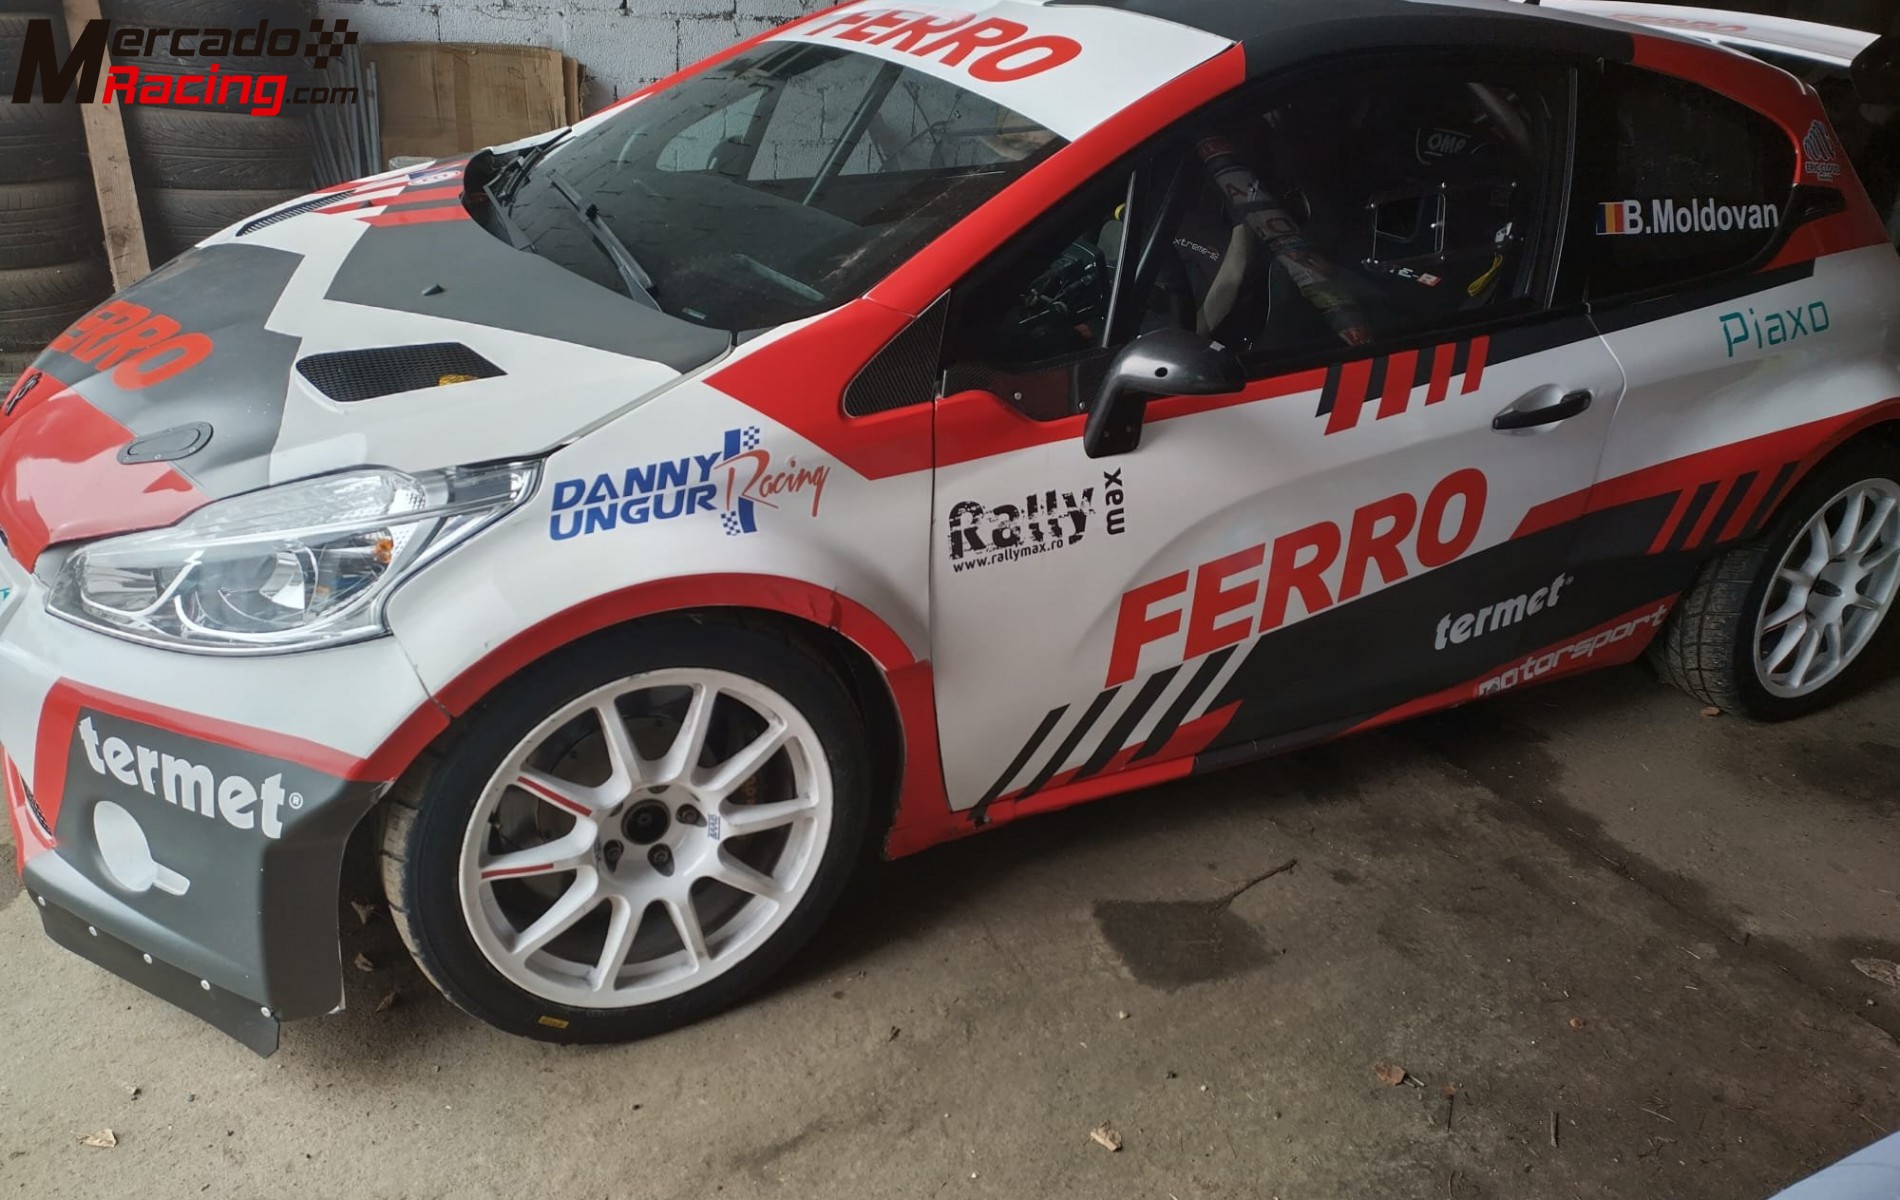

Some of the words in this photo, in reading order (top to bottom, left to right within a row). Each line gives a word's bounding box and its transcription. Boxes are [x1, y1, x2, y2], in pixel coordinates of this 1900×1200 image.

[802, 9, 1083, 83] FERRO
[1623, 198, 1779, 235] B.Moldovan
[1719, 301, 1829, 357] Piaxo
[549, 484, 717, 541] UNGUR
[551, 451, 722, 511] DANNY
[714, 449, 831, 517] Racing
[1103, 467, 1126, 536] max
[949, 487, 1094, 560] Rally
[953, 538, 1064, 573] www.rallymax.ro
[1104, 467, 1488, 689] FERRO
[1478, 604, 1668, 697] motorsport
